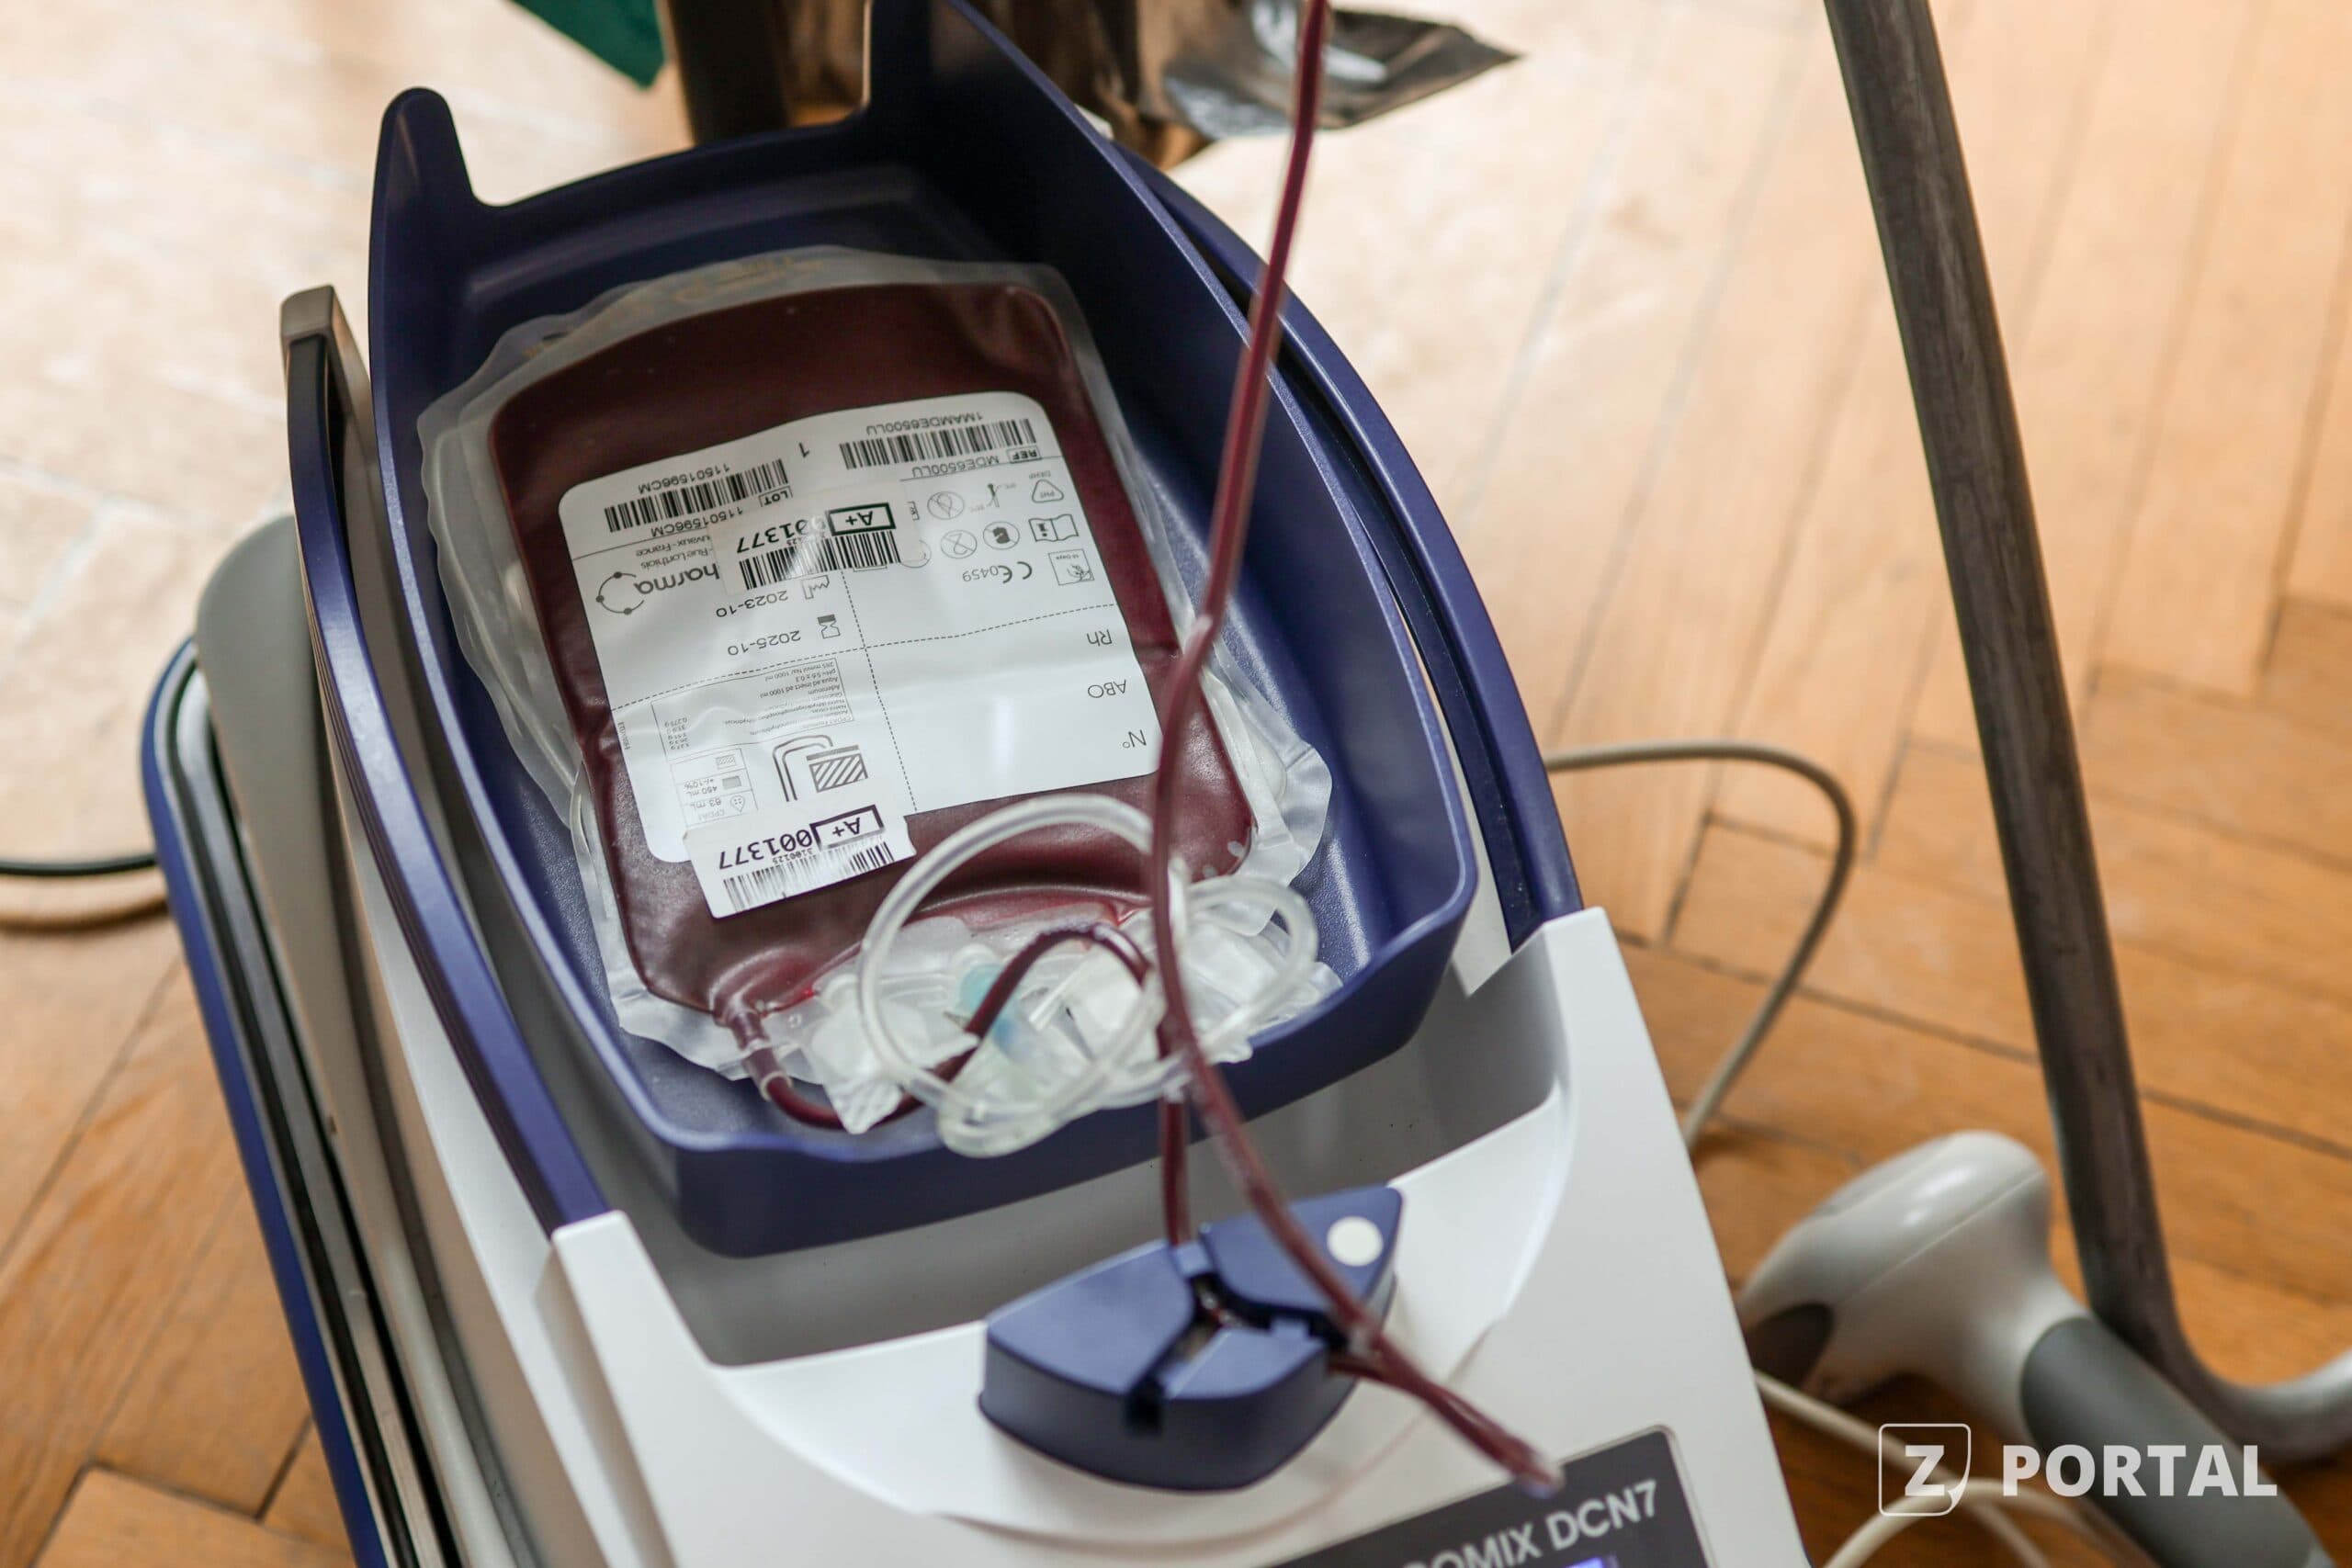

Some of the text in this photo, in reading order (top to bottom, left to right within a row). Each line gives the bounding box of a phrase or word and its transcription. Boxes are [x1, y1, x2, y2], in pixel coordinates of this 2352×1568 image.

[866, 412, 983, 435] 1MAMDE6500LU
[912, 449, 1037, 478] REF MDE6500LU
[639, 463, 729, 494] 11501596CM
[650, 491, 788, 537] LOT 11501596CM
[845, 511, 873, 526] A+
[716, 590, 788, 618] 2023-10
[728, 630, 801, 656] 2025-10
[1086, 629, 1113, 647] Rh
[1088, 679, 1126, 698] ABO
[719, 818, 861, 869] A+ 001377
[1402, 1480, 1657, 1568] OMIX DCN7
